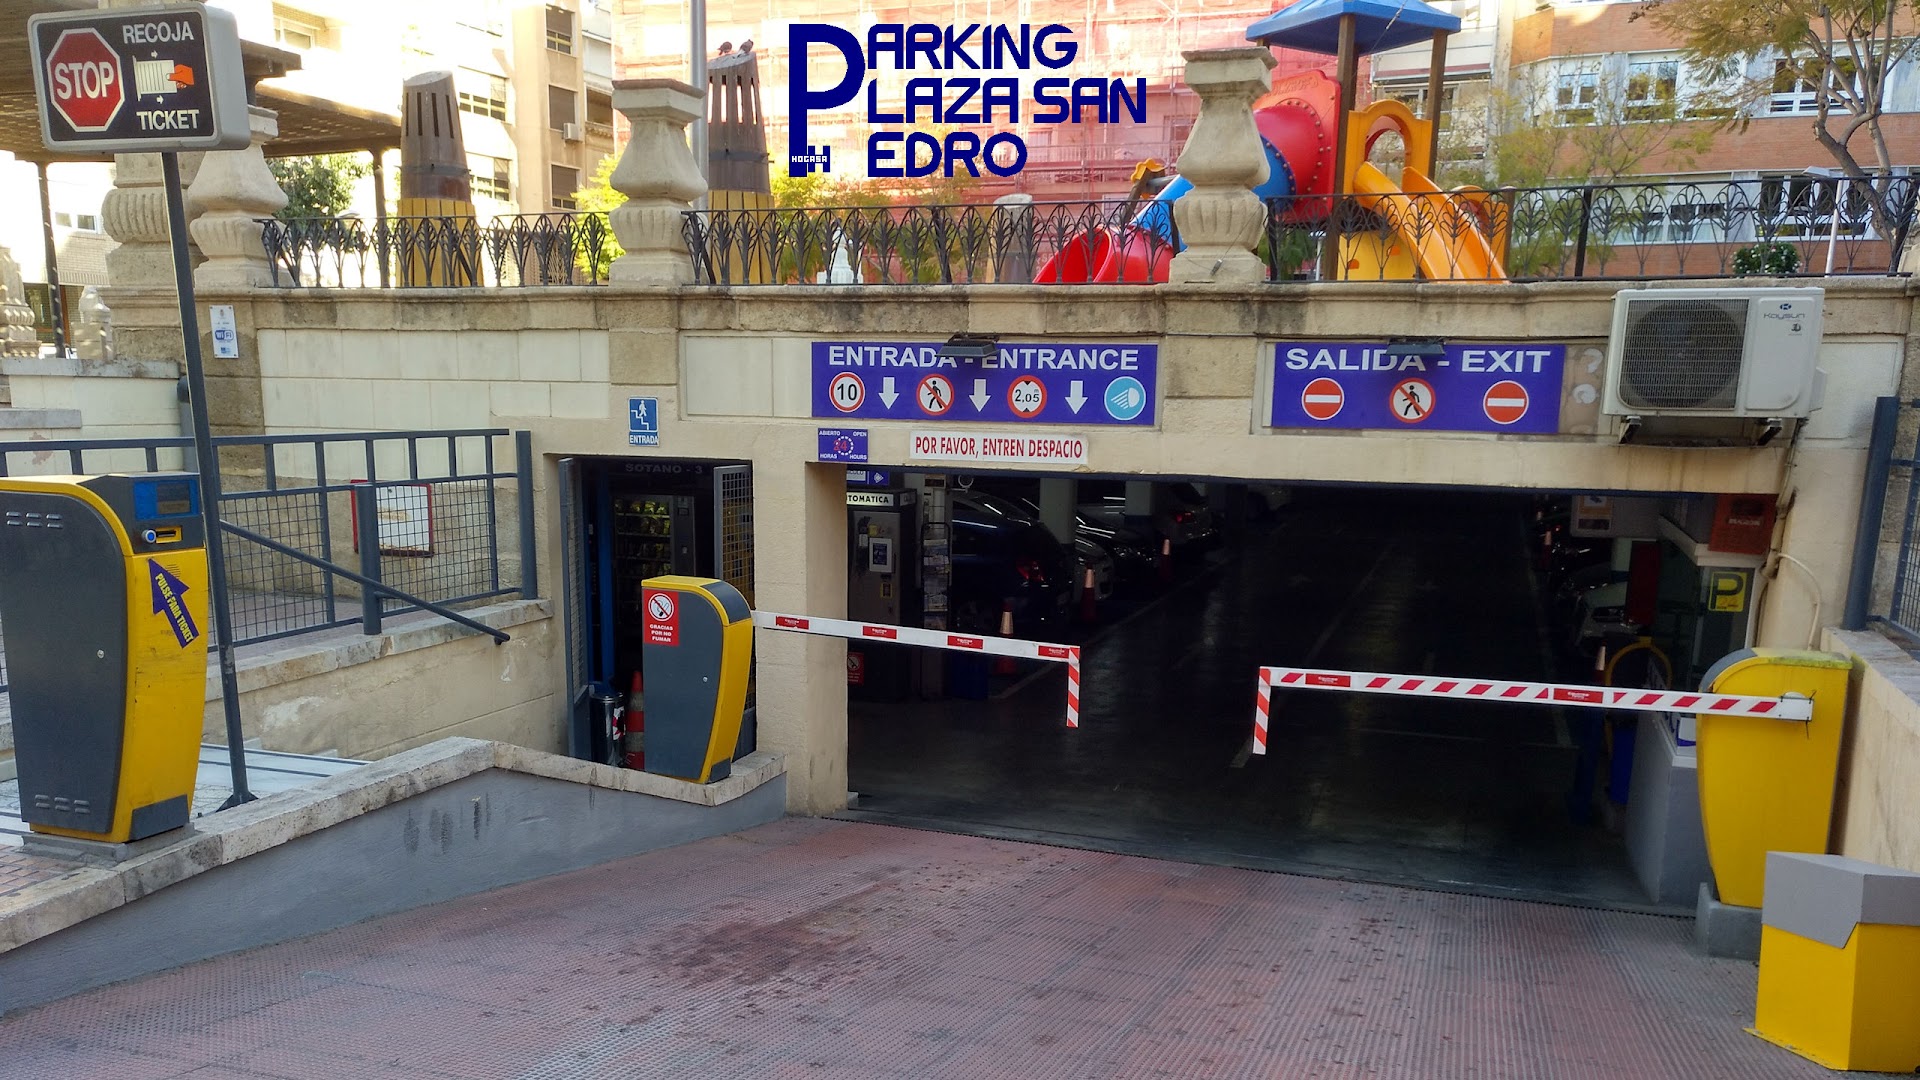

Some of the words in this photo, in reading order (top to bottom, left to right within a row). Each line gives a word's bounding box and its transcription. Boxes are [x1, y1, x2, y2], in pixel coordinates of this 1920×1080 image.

[122, 21, 194, 44] RECOJA
[54, 61, 115, 100] STOP
[136, 109, 200, 131] TICKET
[829, 346, 957, 368] ENTRADA
[981, 348, 1139, 371] ENTRANCE
[1286, 348, 1426, 371] SALIDA
[1461, 351, 1551, 373] EXIT
[836, 384, 858, 401] 10
[629, 434, 659, 445] ENTRADA
[833, 440, 847, 451] 24
[915, 436, 937, 454] POR
[940, 437, 979, 458] FAVOR,
[982, 438, 1025, 456] ENTREN
[1028, 439, 1083, 458] DESPACIO
[625, 463, 682, 473] SOTANO
[695, 465, 703, 474] 3
[155, 573, 173, 600] PULSE
[167, 596, 182, 619] PARA
[177, 615, 194, 643] TICKET
